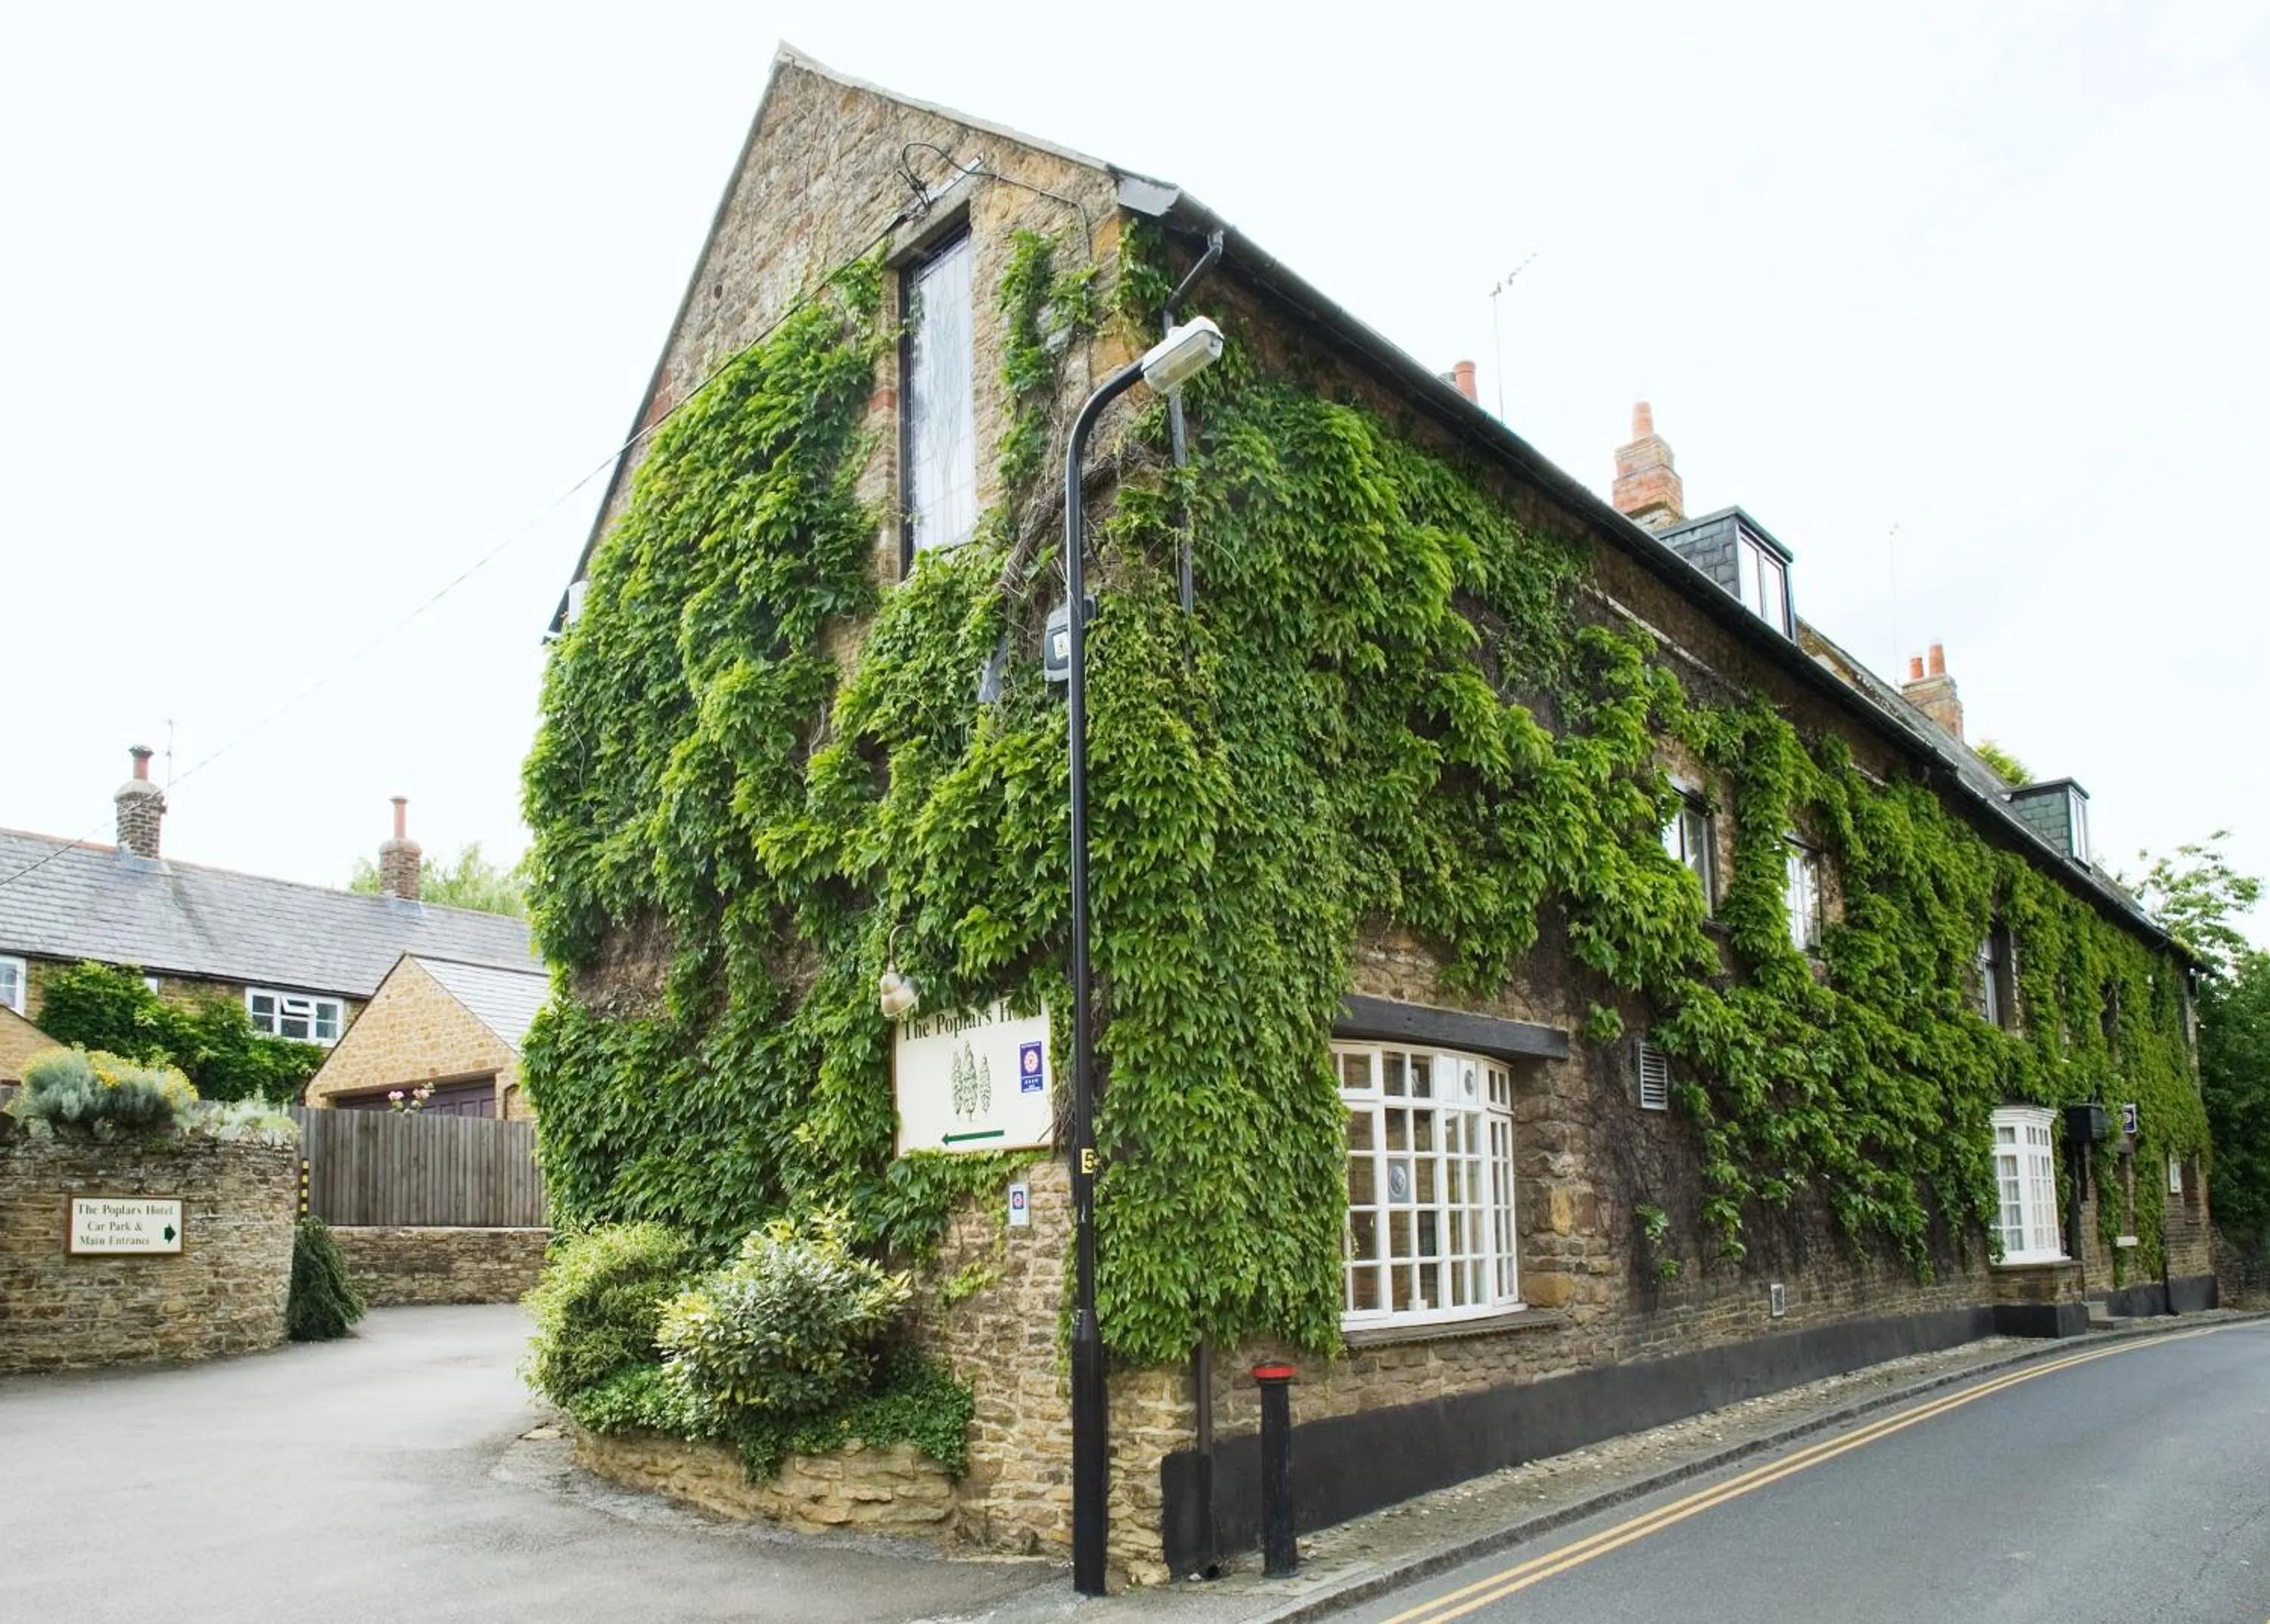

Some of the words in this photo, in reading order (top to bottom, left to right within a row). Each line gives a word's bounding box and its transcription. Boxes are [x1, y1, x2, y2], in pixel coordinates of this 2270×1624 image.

[902, 1018, 930, 1040] The
[79, 1204, 97, 1215] The
[103, 1204, 141, 1218] Poplars
[146, 1205, 173, 1215] Hotel
[87, 1221, 105, 1231] Car
[110, 1221, 131, 1231] Park
[134, 1222, 143, 1231] &
[79, 1235, 105, 1246] Main
[108, 1235, 150, 1246] Entrance
